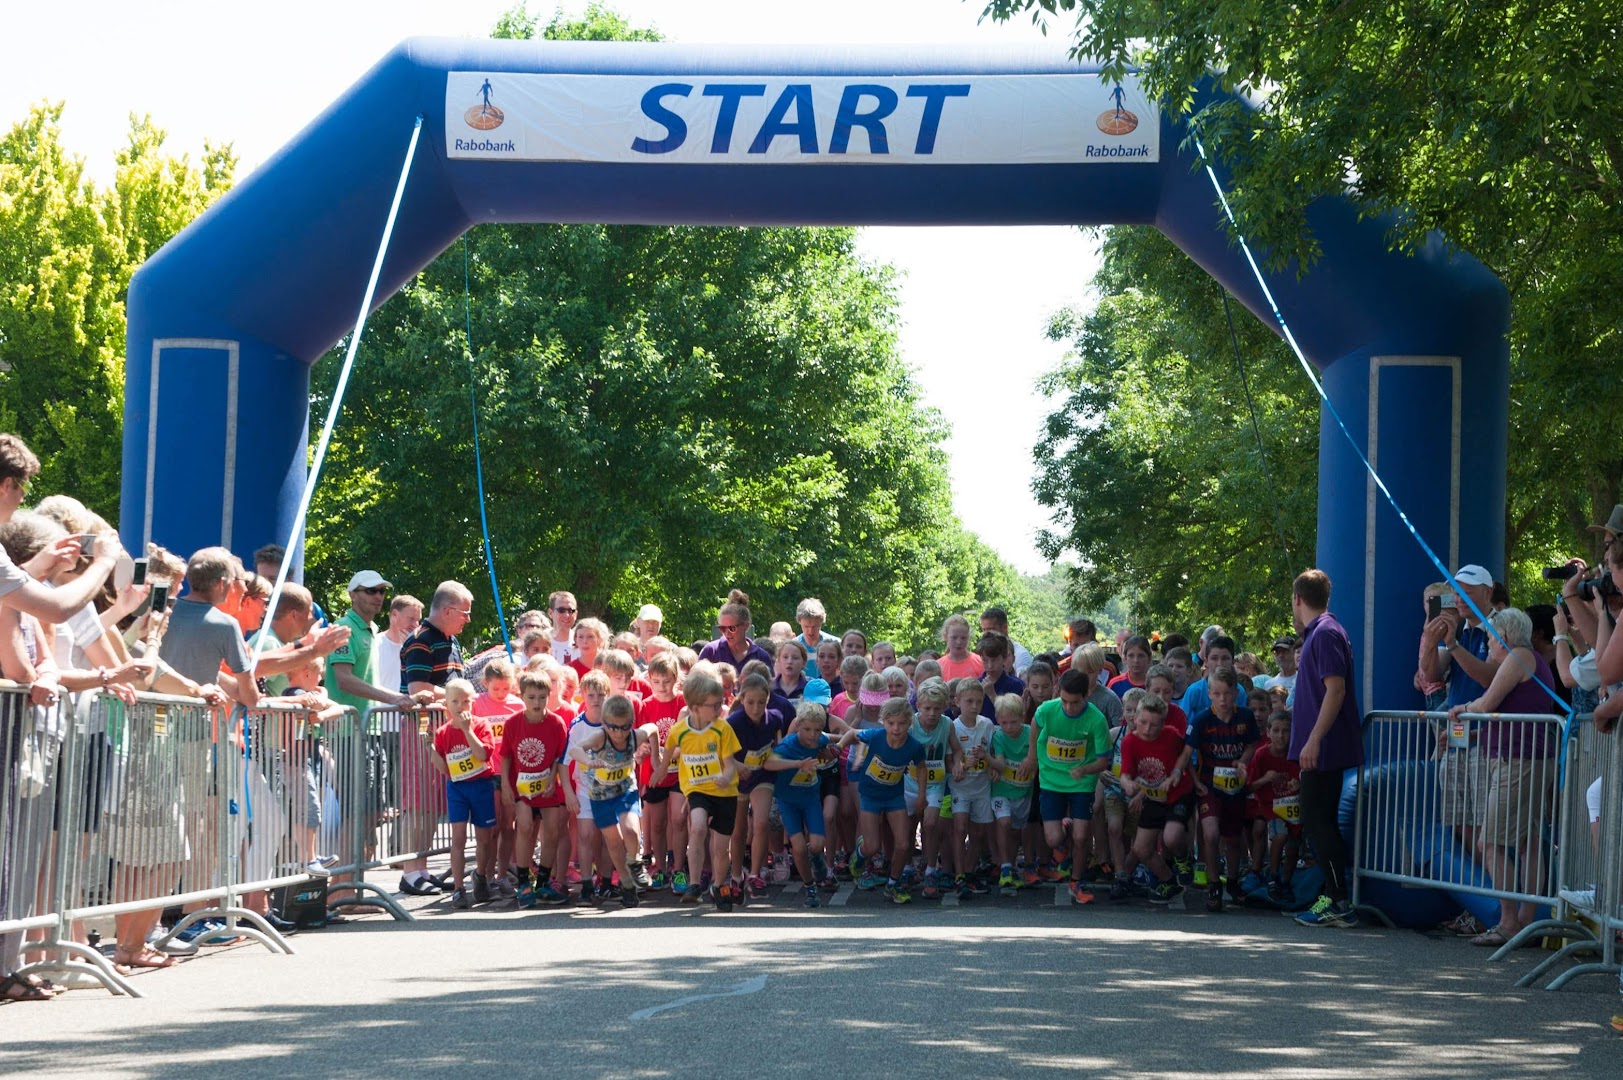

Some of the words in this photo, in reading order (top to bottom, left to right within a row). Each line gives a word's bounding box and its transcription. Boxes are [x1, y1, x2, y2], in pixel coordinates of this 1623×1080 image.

[630, 82, 971, 155] START
[455, 138, 515, 152] Rabobank
[1085, 144, 1149, 157] Rabobank
[1055, 739, 1084, 747] Rabobank
[1210, 743, 1244, 755] QATAR
[1057, 747, 1077, 758] 112
[458, 758, 474, 773] 65
[690, 763, 710, 779] 131
[606, 768, 624, 781] 110
[878, 770, 892, 781] 21
[529, 780, 542, 793] 56
[1286, 805, 1300, 818] 59
